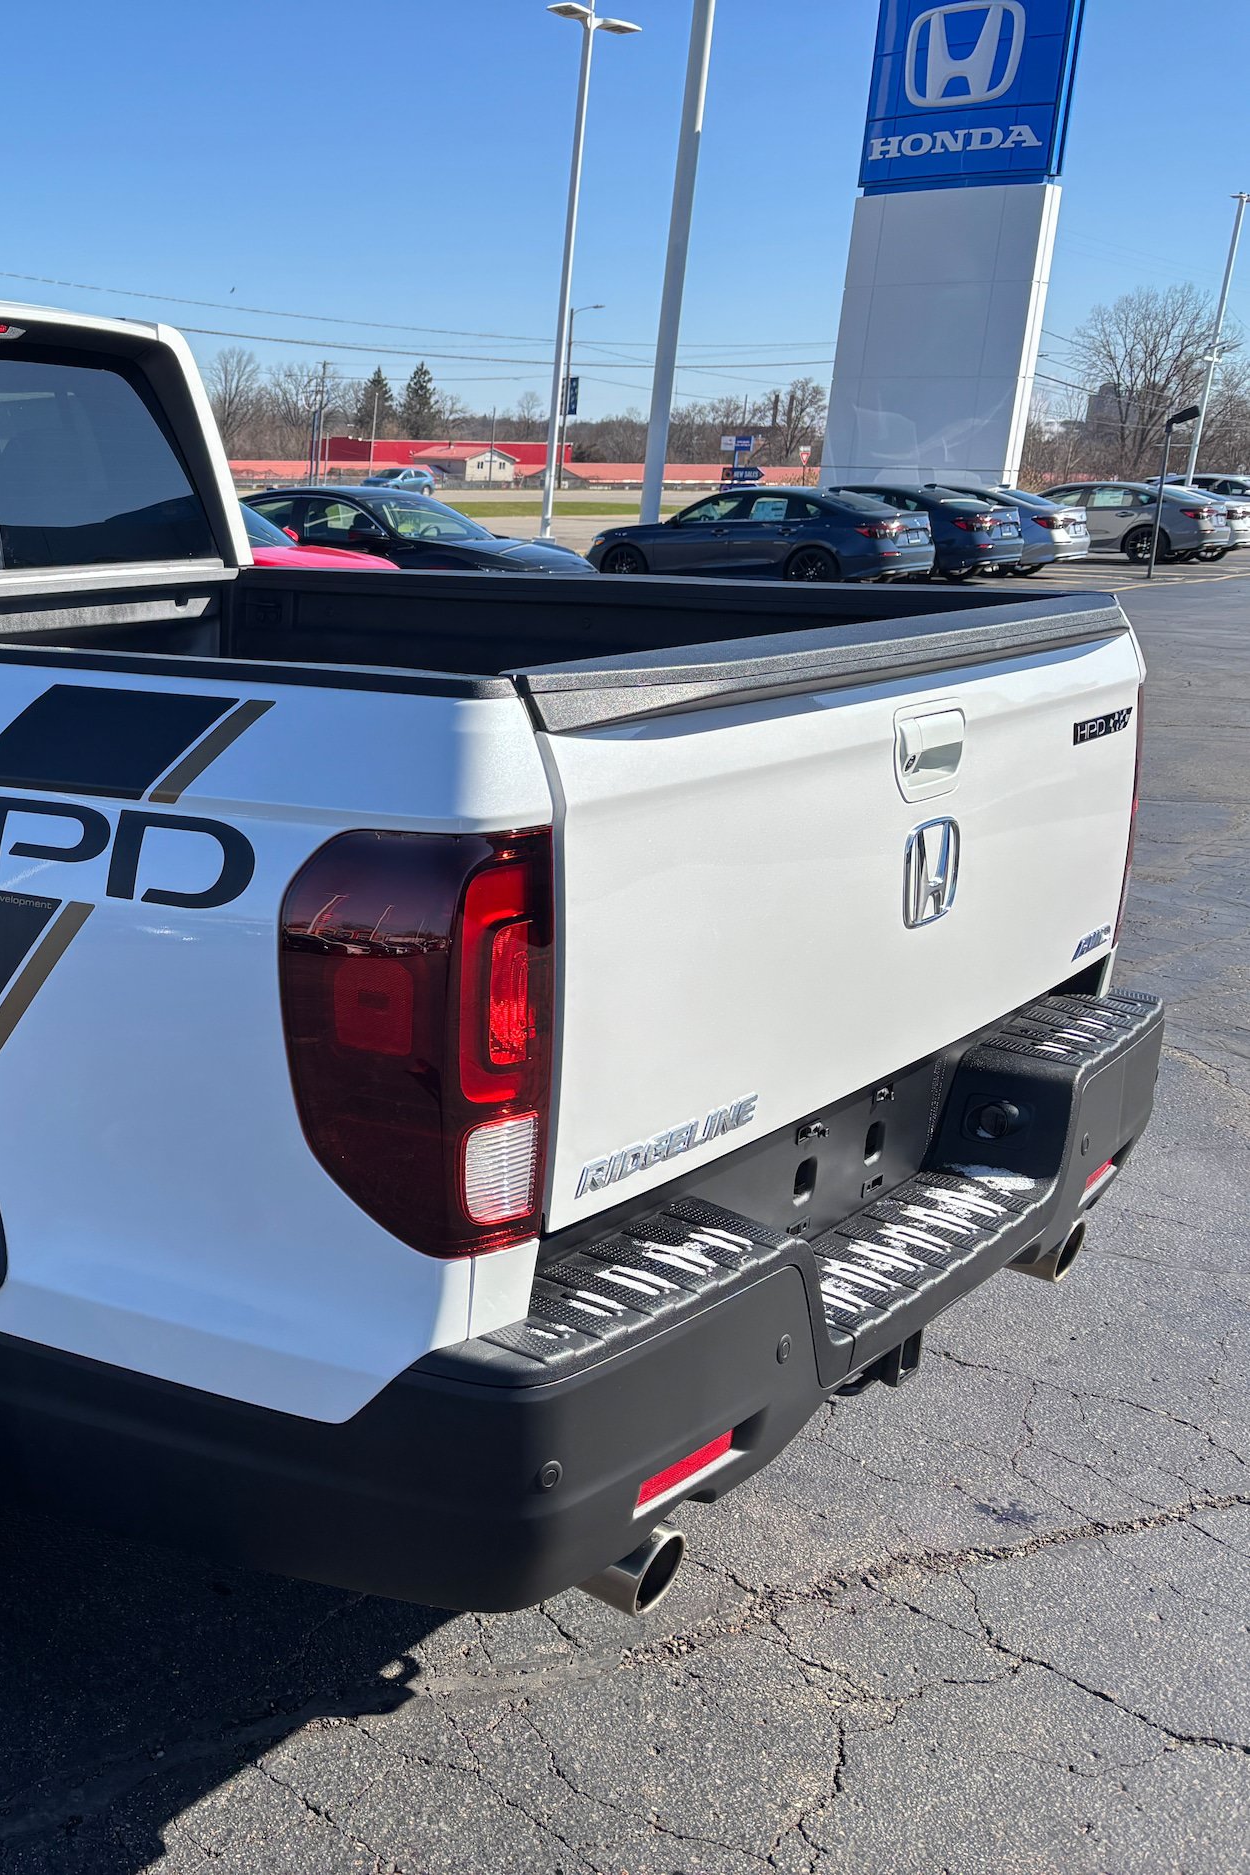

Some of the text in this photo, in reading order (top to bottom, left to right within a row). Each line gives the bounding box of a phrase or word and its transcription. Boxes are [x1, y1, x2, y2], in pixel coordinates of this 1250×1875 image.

[867, 124, 1043, 161] HONDA
[1077, 719, 1106, 742] HPD
[574, 1091, 759, 1200] RIDGELINE
